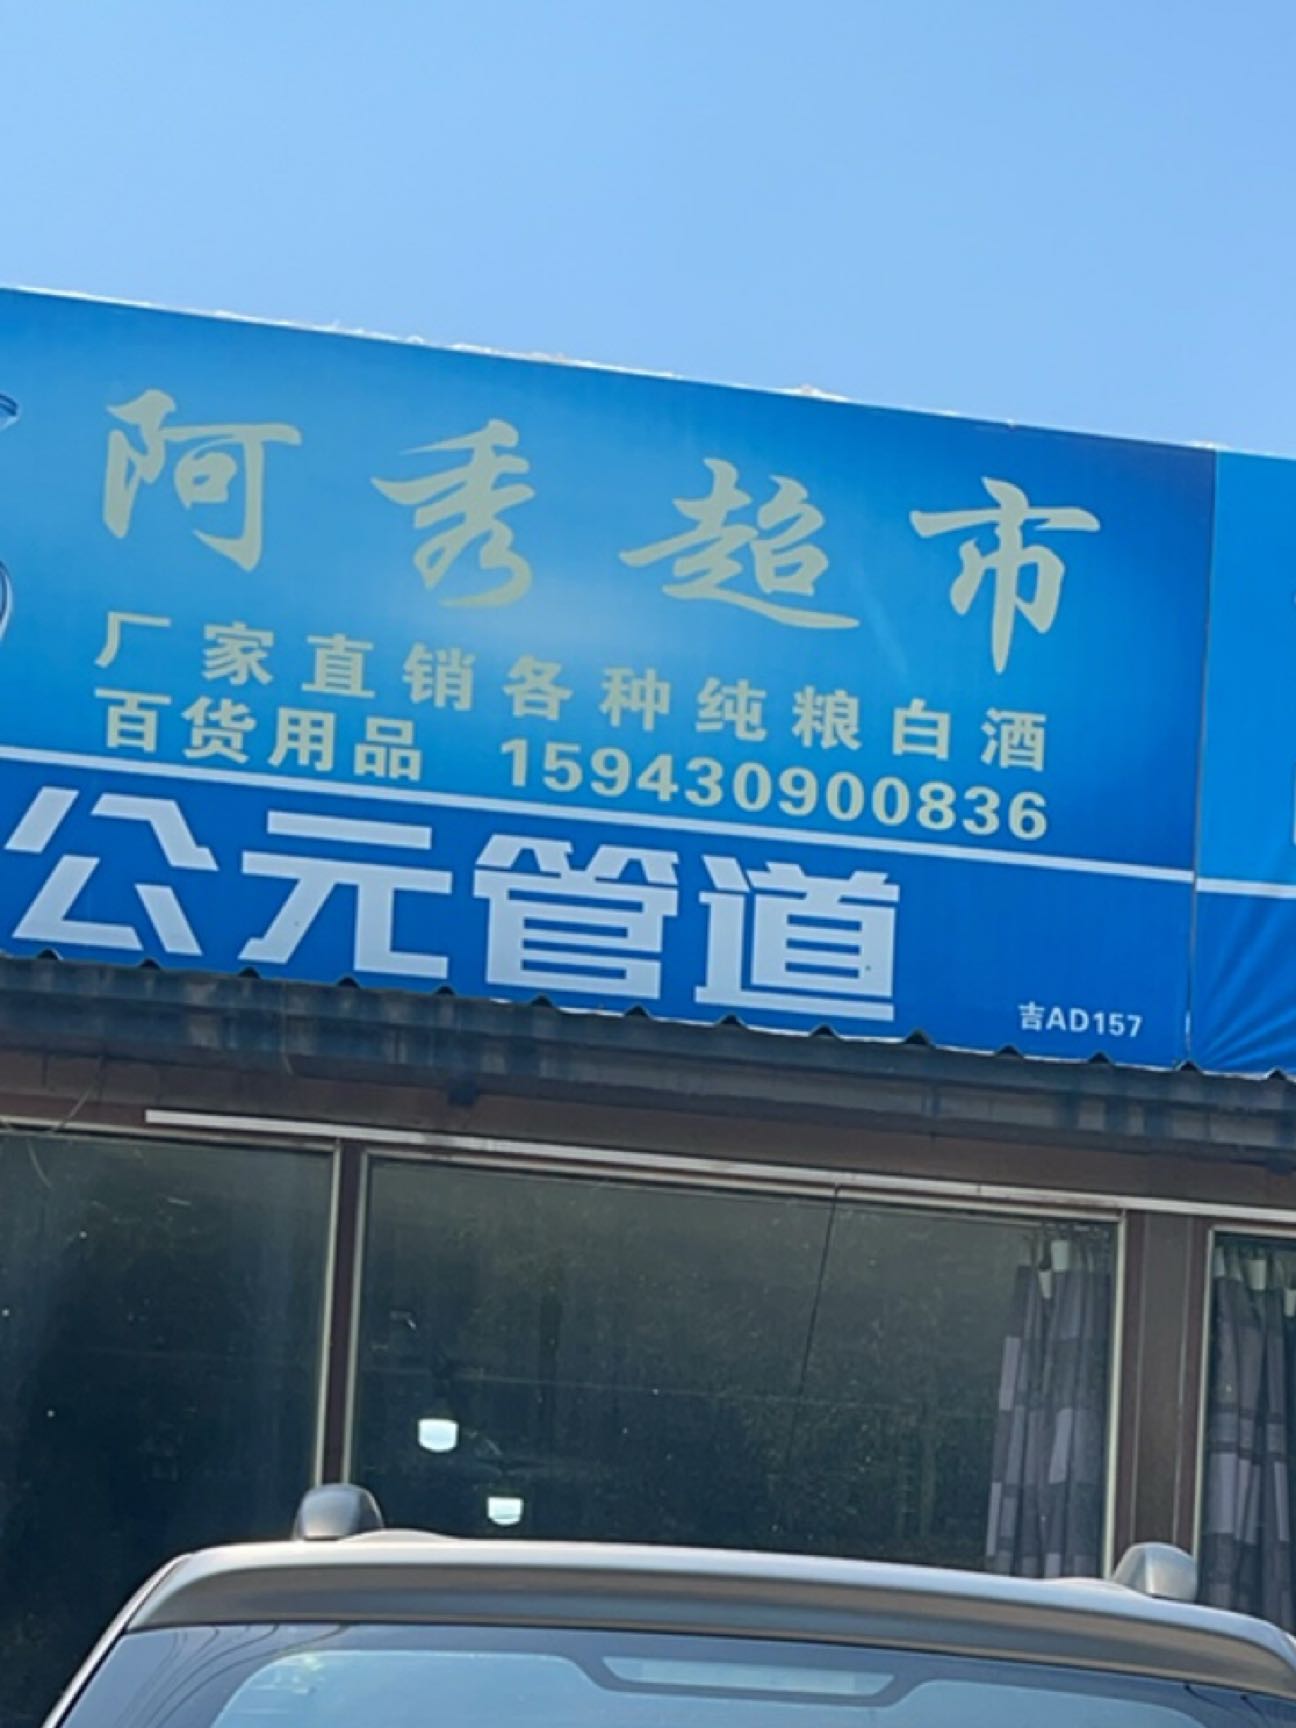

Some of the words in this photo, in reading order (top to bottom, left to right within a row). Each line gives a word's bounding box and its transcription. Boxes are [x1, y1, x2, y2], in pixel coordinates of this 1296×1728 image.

[103, 388, 1101, 674] 阿秀超市
[94, 611, 1047, 772] 厂家直销各种纯粮白酒
[94, 687, 422, 781] 百货用品
[500, 738, 1048, 841] 159430900836
[4, 786, 900, 1021] 公元管道
[1018, 1000, 1143, 1037] 吉AD157
